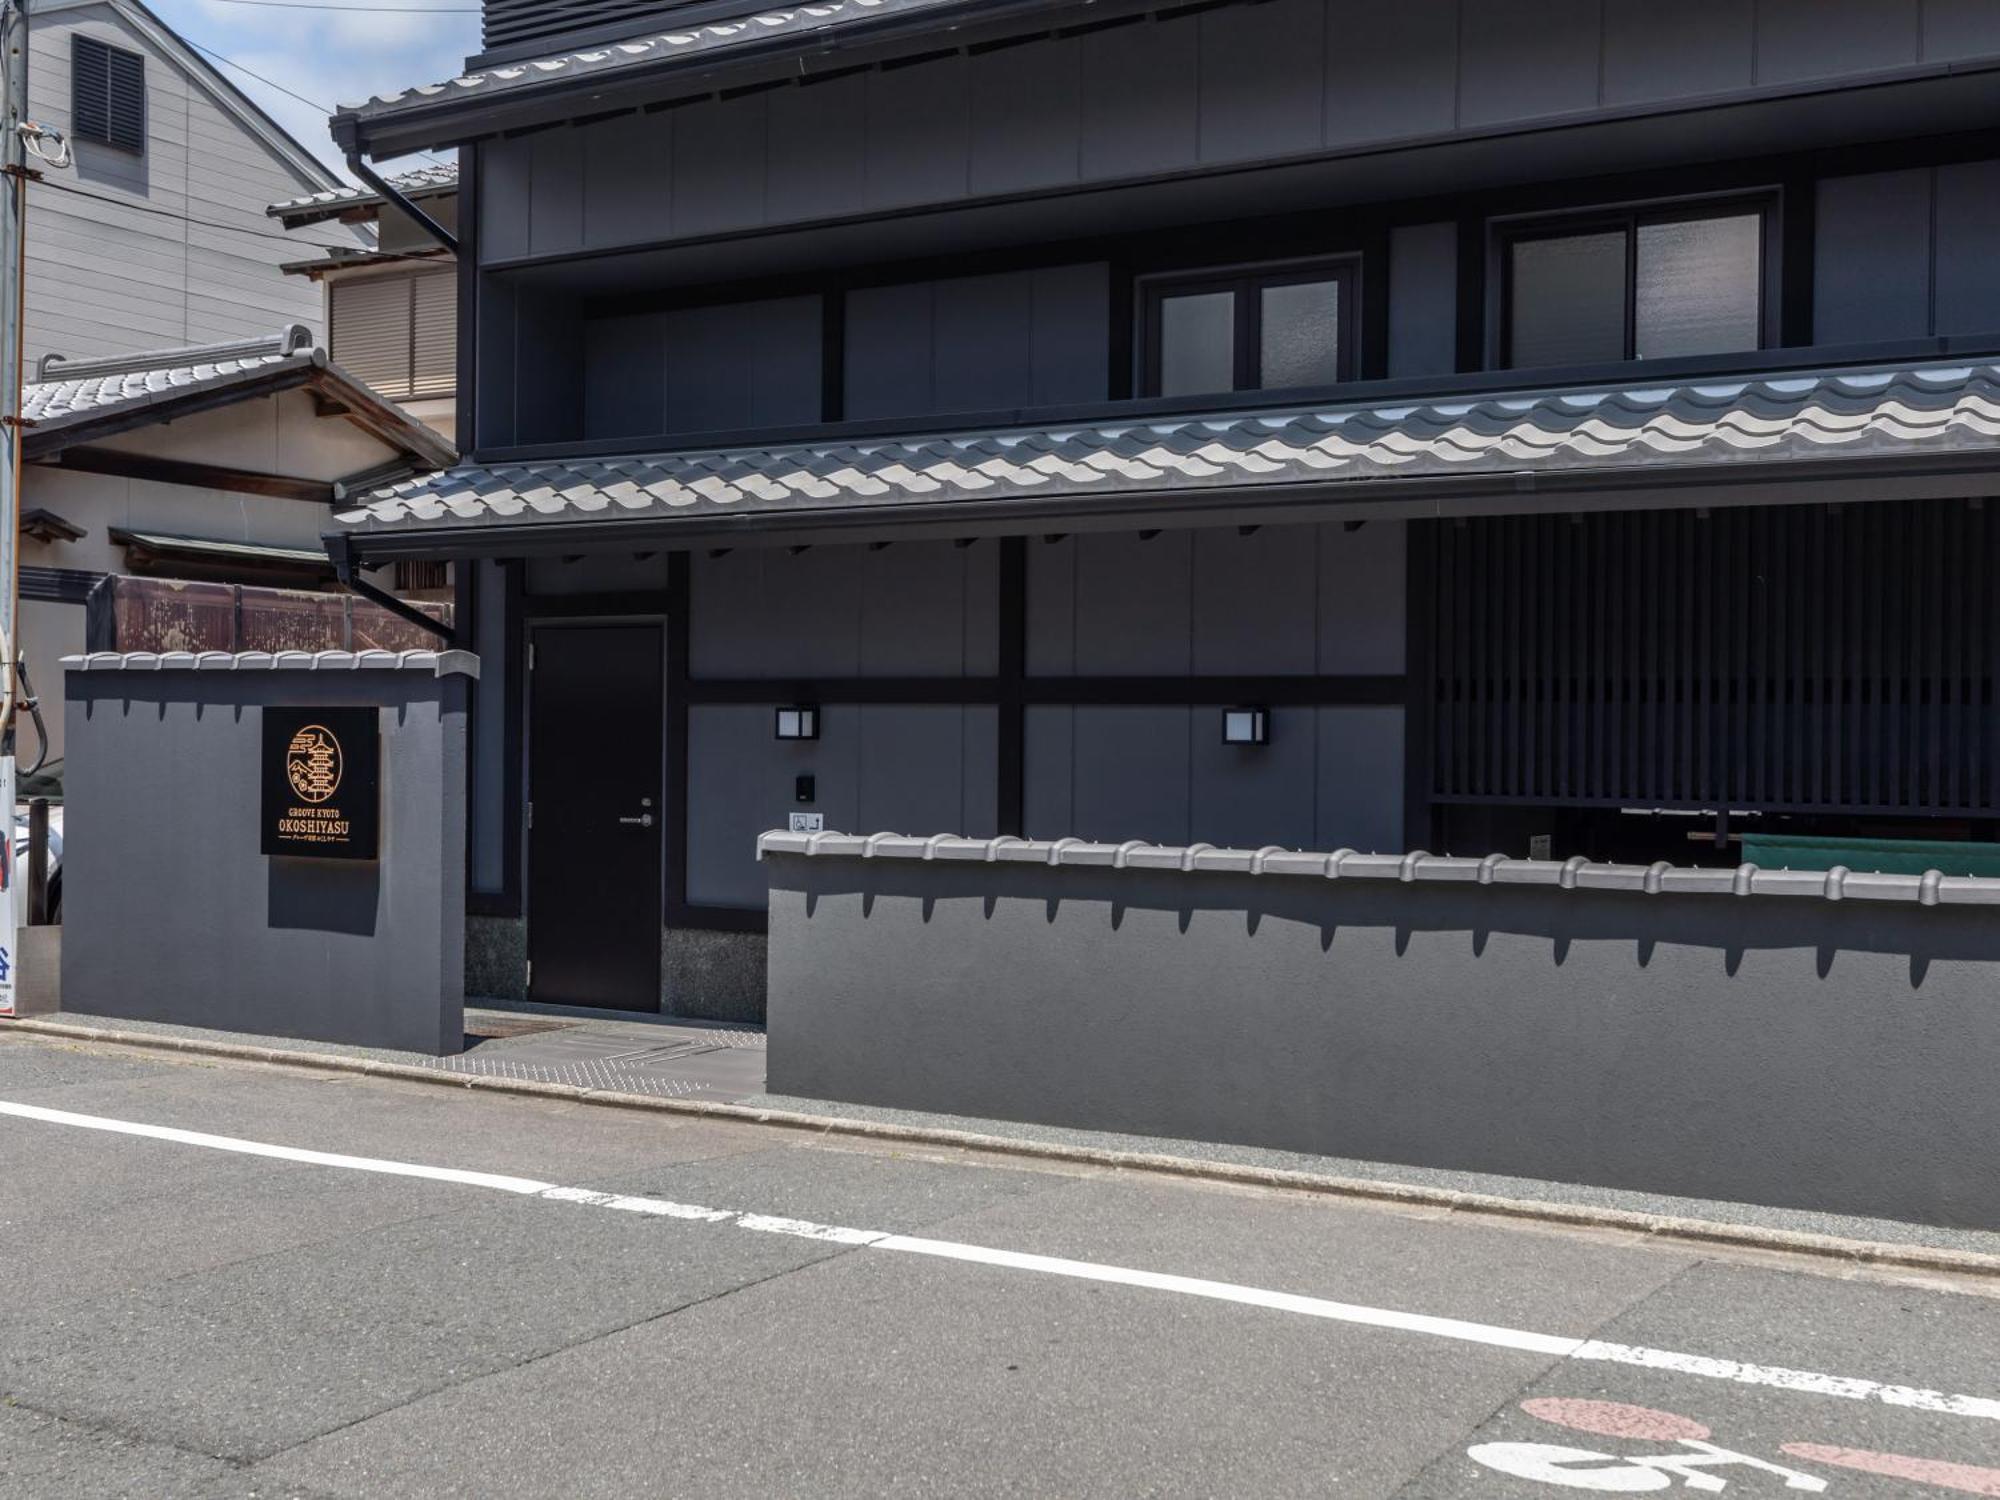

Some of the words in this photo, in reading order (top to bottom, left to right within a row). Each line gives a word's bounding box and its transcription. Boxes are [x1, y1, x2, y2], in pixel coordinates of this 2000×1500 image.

[288, 807, 316, 818] GROOVE
[316, 808, 340, 819] KYOTO
[278, 819, 350, 835] OKOSHIYASU
